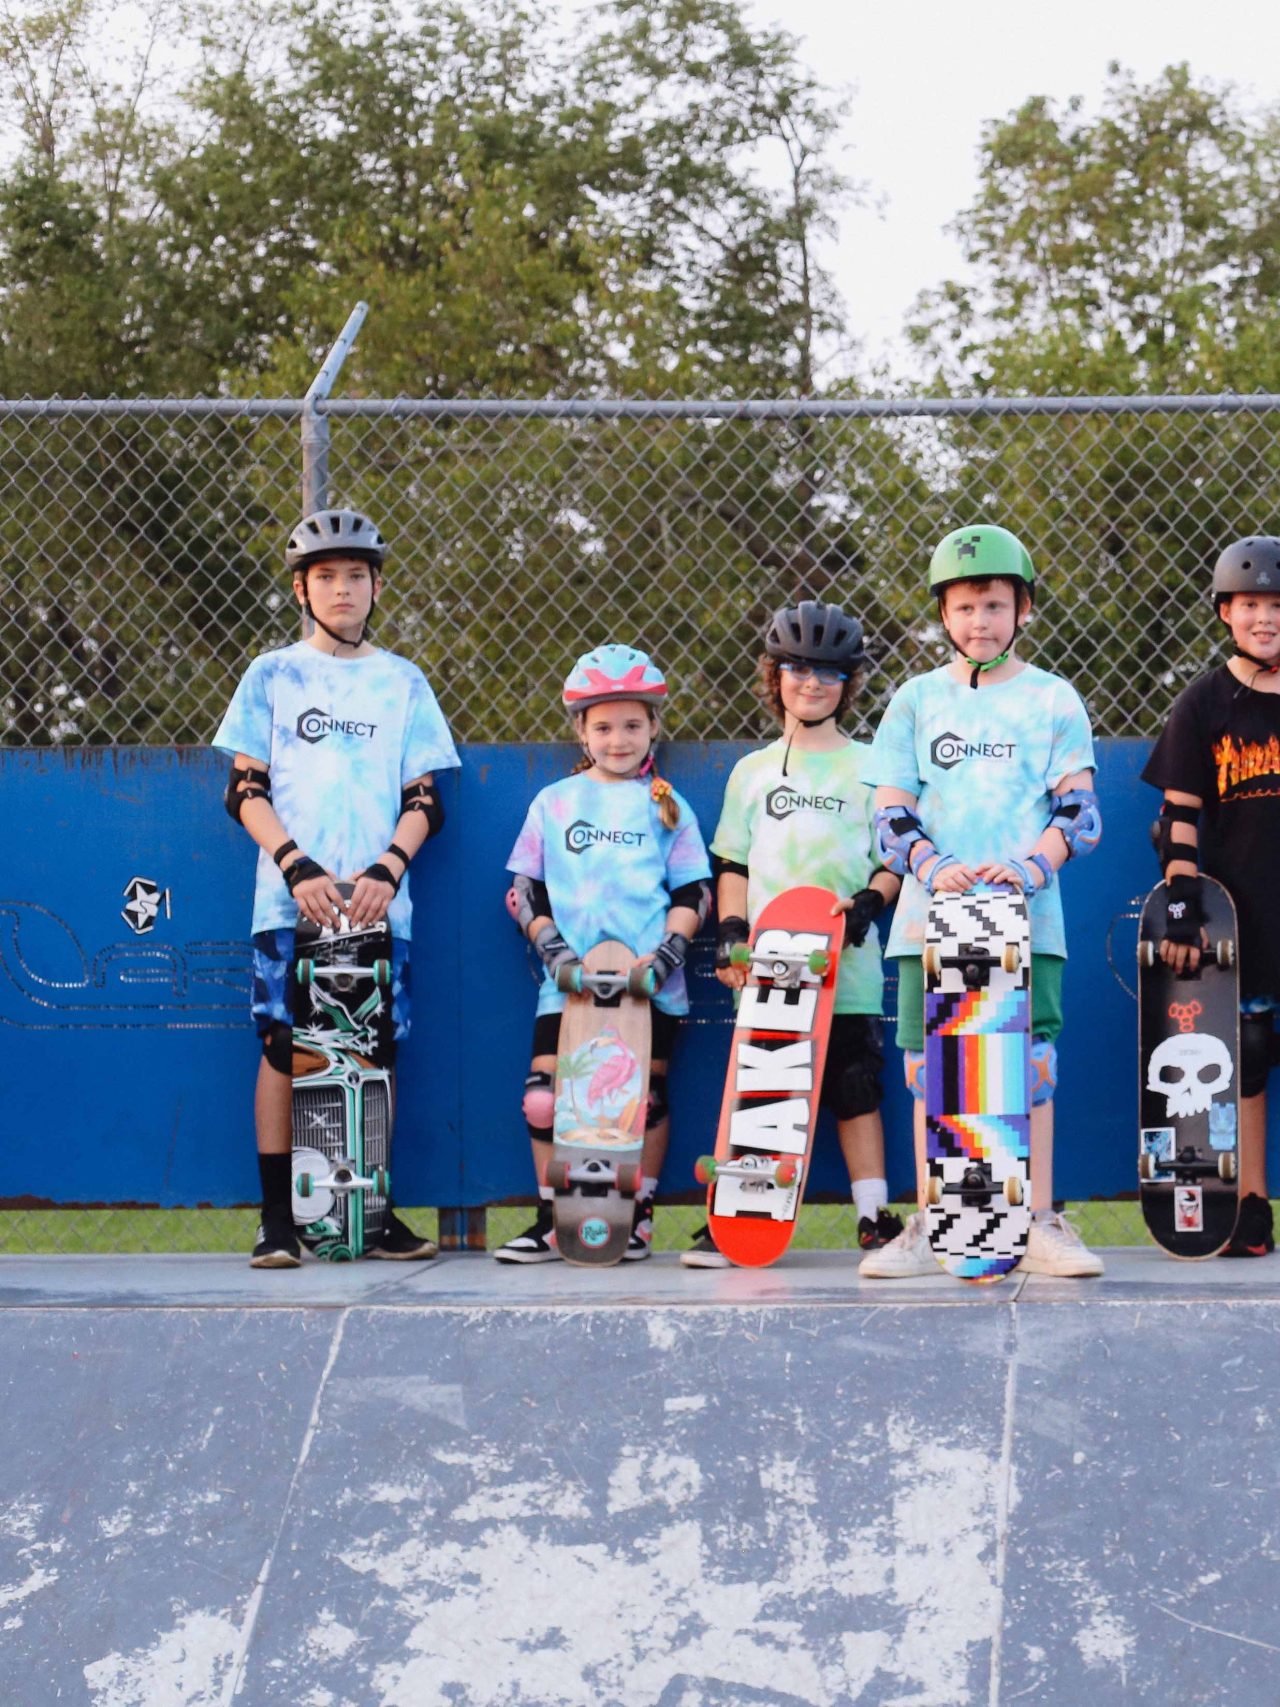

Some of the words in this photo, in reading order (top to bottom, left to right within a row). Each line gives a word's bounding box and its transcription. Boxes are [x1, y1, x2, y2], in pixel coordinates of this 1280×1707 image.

[296, 706, 378, 744] CONNECT
[930, 731, 1017, 770] CONNECT
[765, 785, 848, 821] CONNECT
[565, 819, 647, 855] CONNECT
